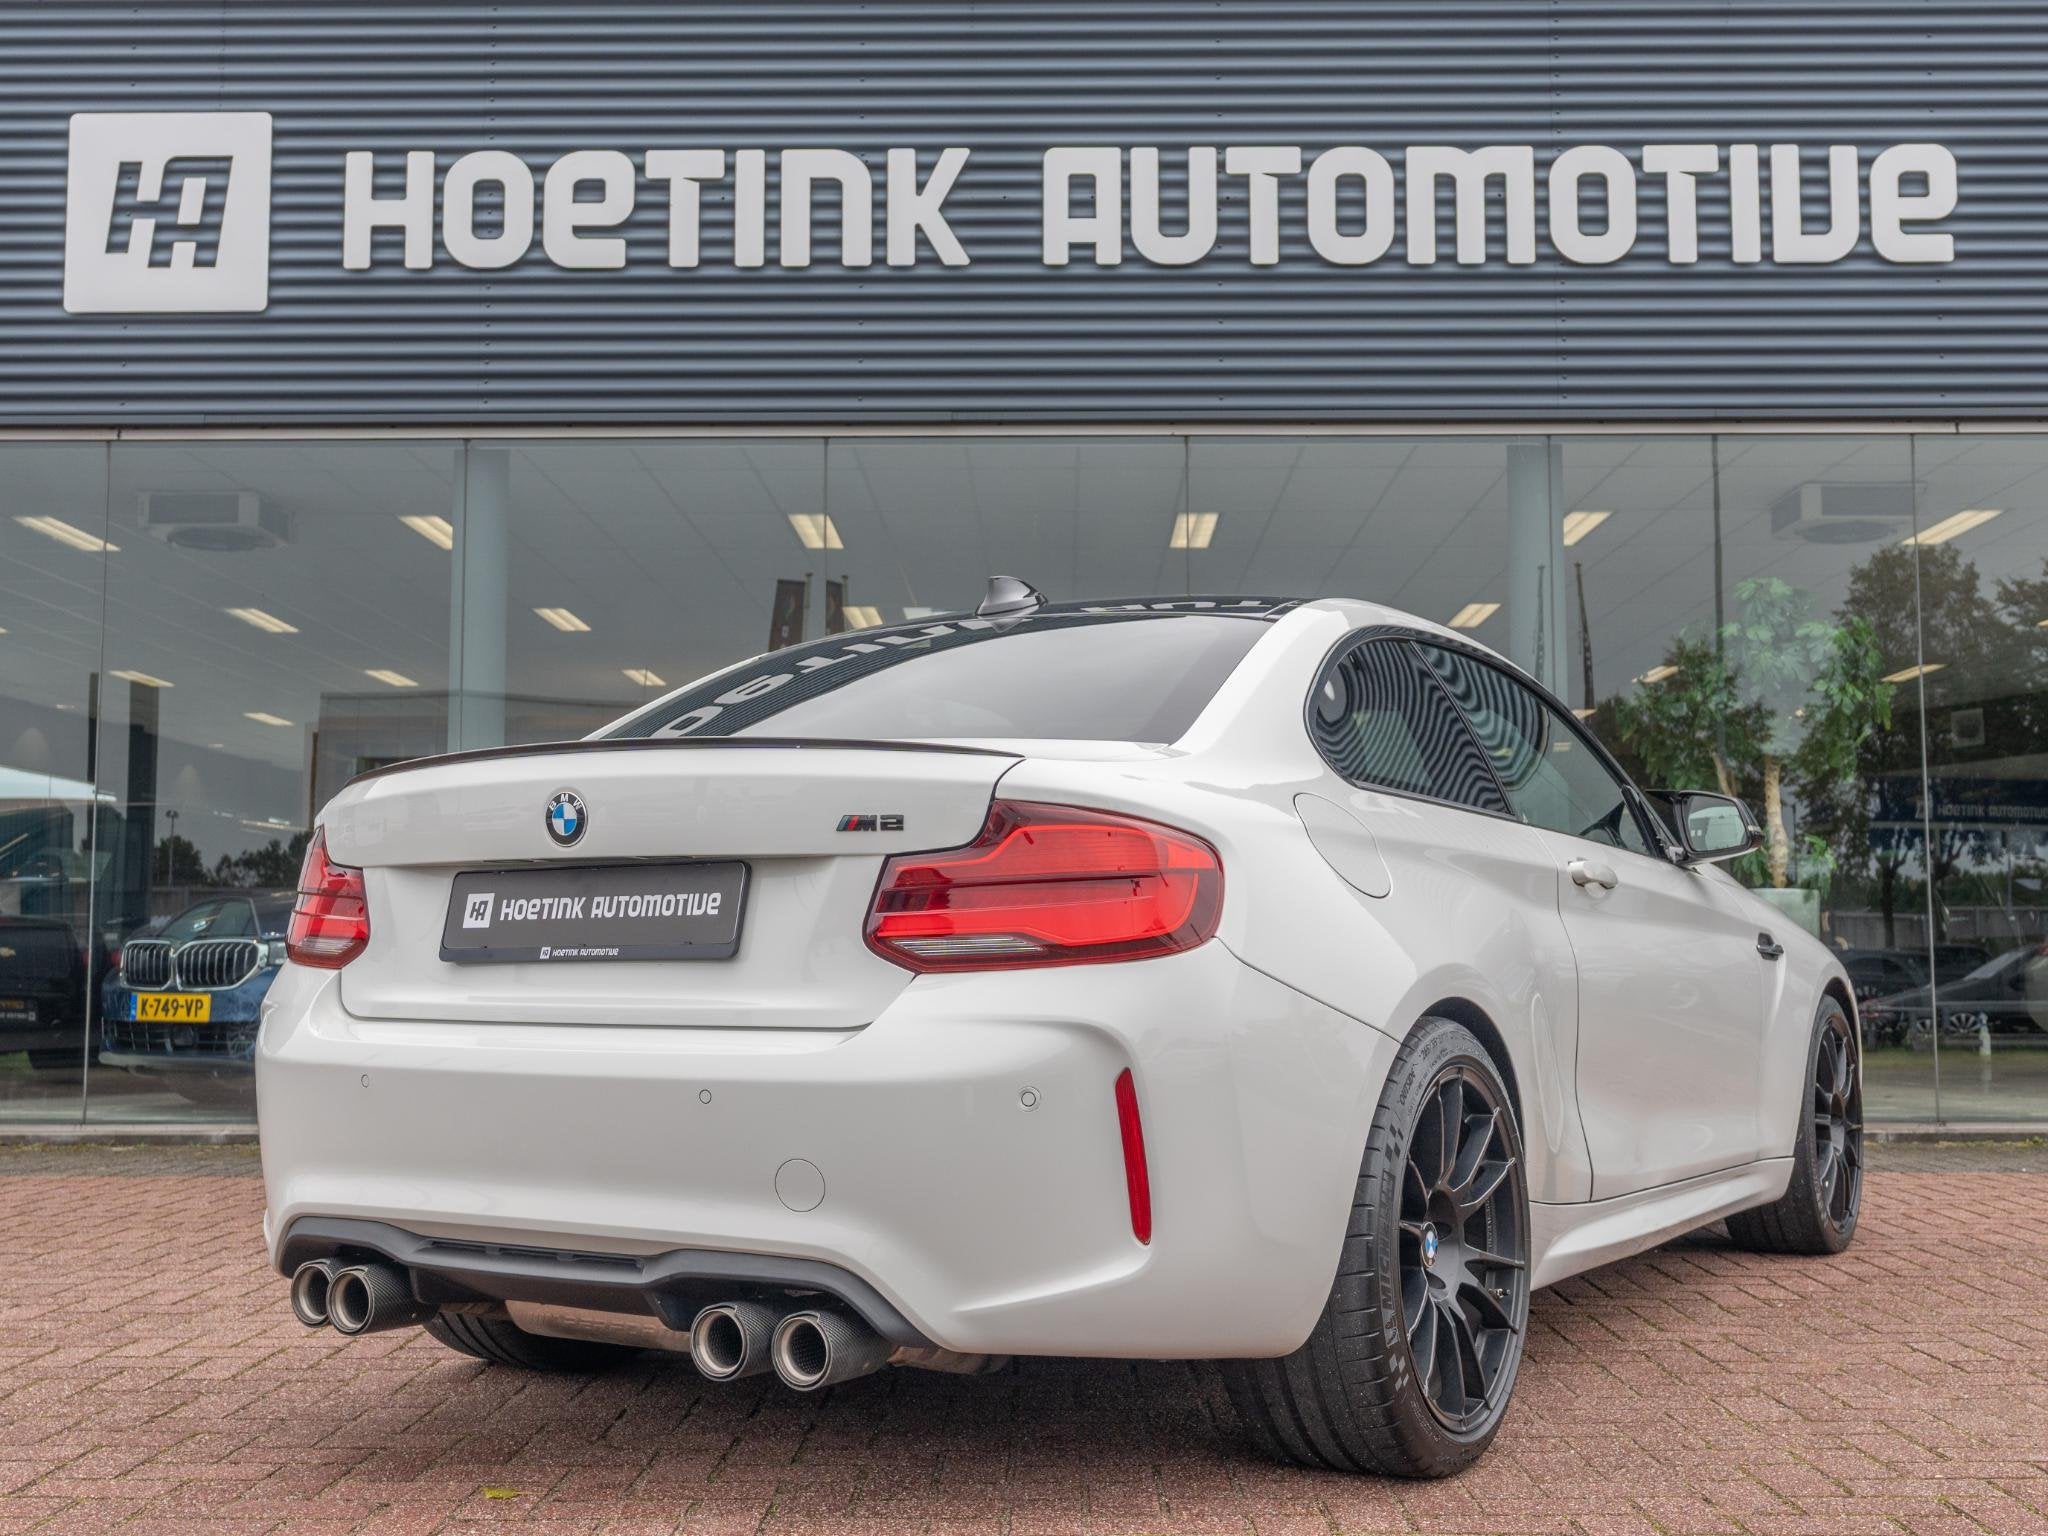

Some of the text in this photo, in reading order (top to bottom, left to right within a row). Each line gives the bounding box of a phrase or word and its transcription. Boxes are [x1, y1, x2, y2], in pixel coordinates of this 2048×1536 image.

[343, 143, 1959, 269] HOETINK AUTOMOTIVE
[549, 793, 583, 811] BMW
[852, 815, 904, 831] M2
[500, 892, 722, 921] HOETINK AUTOMOTIVE
[552, 948, 580, 957] HOETINK
[141, 996, 203, 1017] K-749-VP
